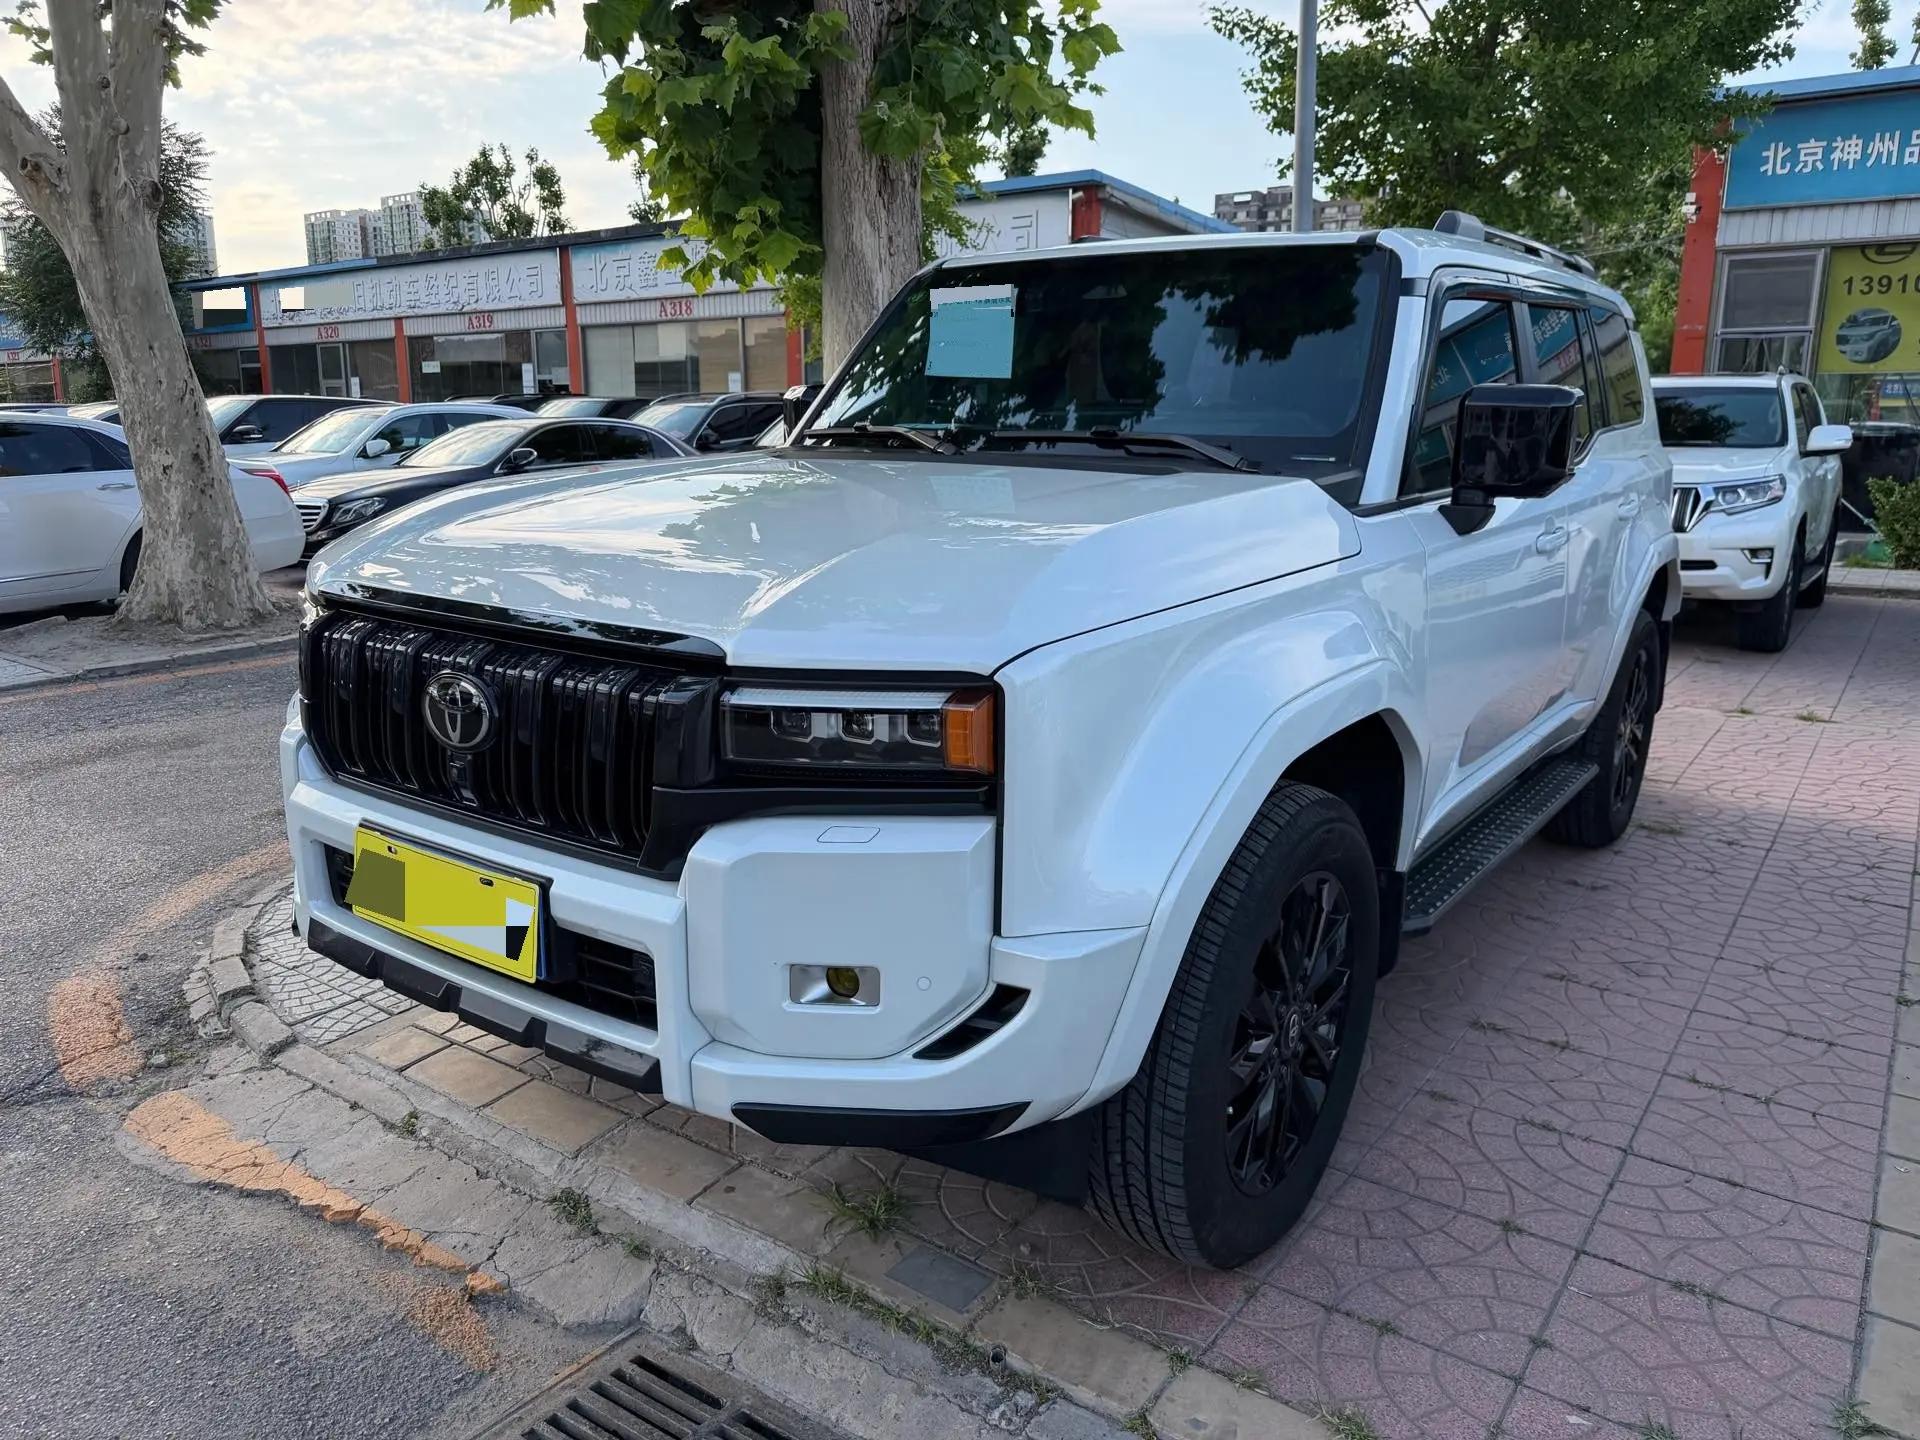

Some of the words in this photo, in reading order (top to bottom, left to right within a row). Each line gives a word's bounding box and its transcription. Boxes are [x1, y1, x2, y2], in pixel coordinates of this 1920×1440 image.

[659, 297, 693, 319] A318
[467, 314, 493, 331] A319
[317, 325, 340, 341] A320
